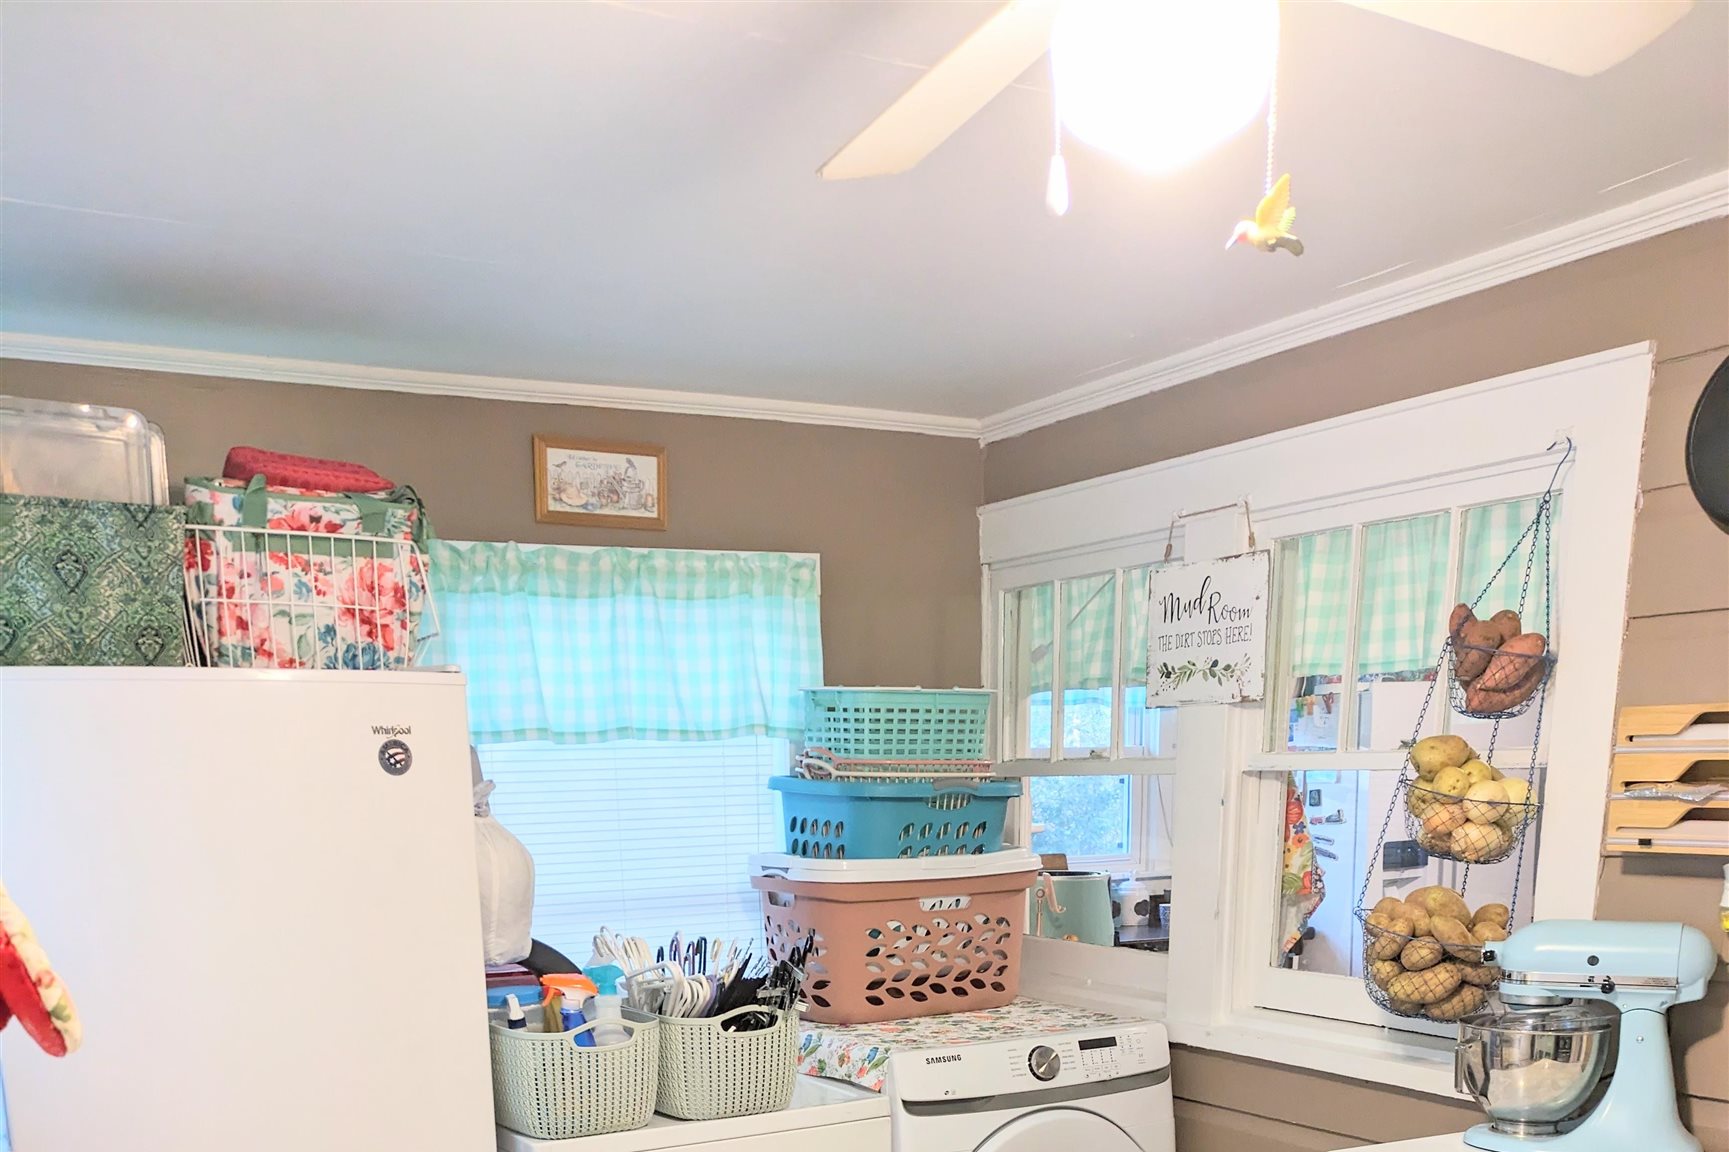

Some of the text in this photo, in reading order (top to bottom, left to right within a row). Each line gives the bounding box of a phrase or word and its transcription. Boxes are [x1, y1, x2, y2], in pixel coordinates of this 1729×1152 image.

[1159, 575, 1250, 625] Mud Room
[1158, 623, 1253, 652] THE DIRT STOPS HERE!
[371, 724, 411, 738] Whirlpool
[925, 1054, 962, 1065] SAMSUNG
